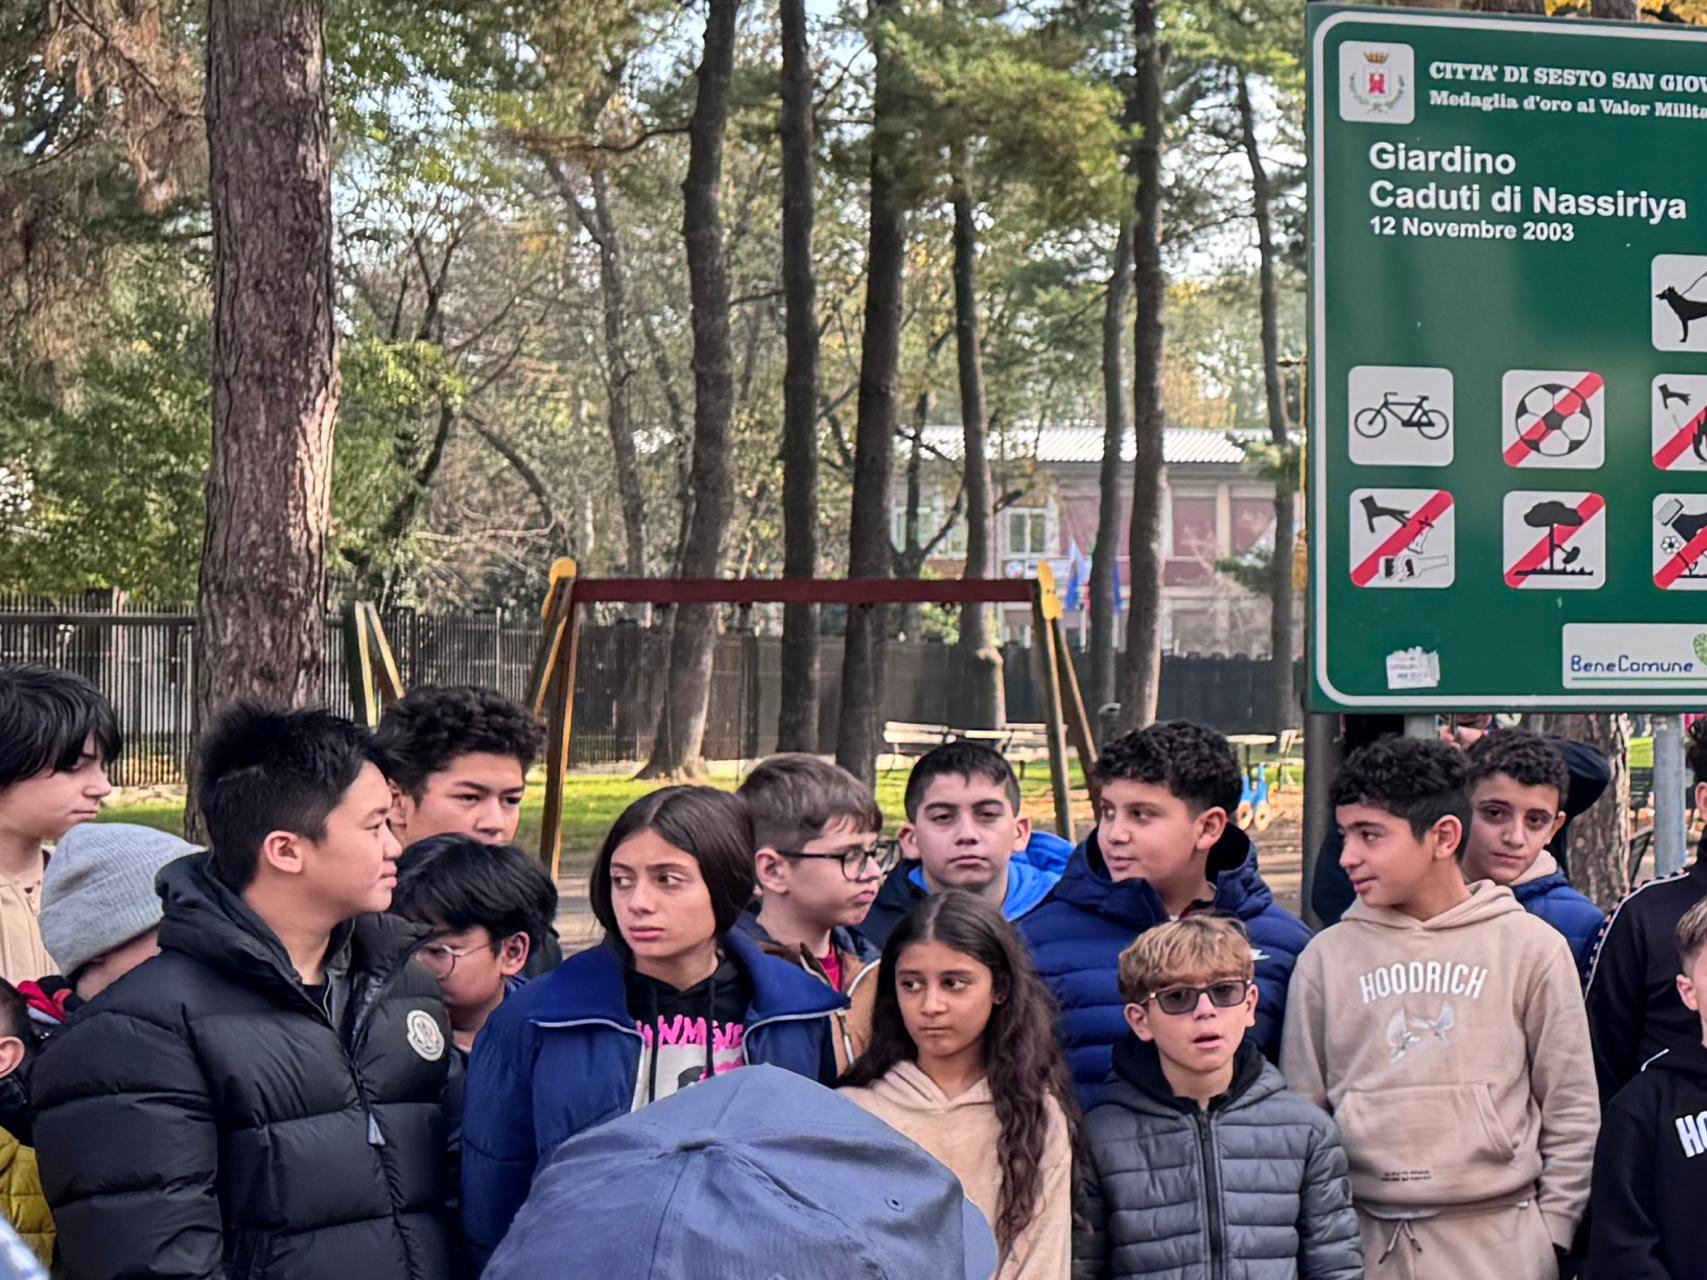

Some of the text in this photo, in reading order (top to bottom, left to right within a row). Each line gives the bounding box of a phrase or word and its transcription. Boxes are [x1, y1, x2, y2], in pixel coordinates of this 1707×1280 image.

[1429, 61, 1498, 81] CITTA'
[1503, 66, 1529, 84] DI
[1534, 67, 1606, 88] SESTO
[1612, 71, 1654, 91] SAN
[1429, 90, 1519, 111] Medaglia
[1523, 95, 1572, 113] d'oro
[1577, 97, 1596, 113] al
[1600, 98, 1650, 116] Valor
[1369, 141, 1516, 175] Giardino
[1369, 180, 1687, 225] Caduti di Nassiriya
[1370, 216, 1575, 242] 12 Novembre 2003
[1571, 654, 1694, 672] BeneComune
[1360, 961, 1488, 1004] HOODRICH
